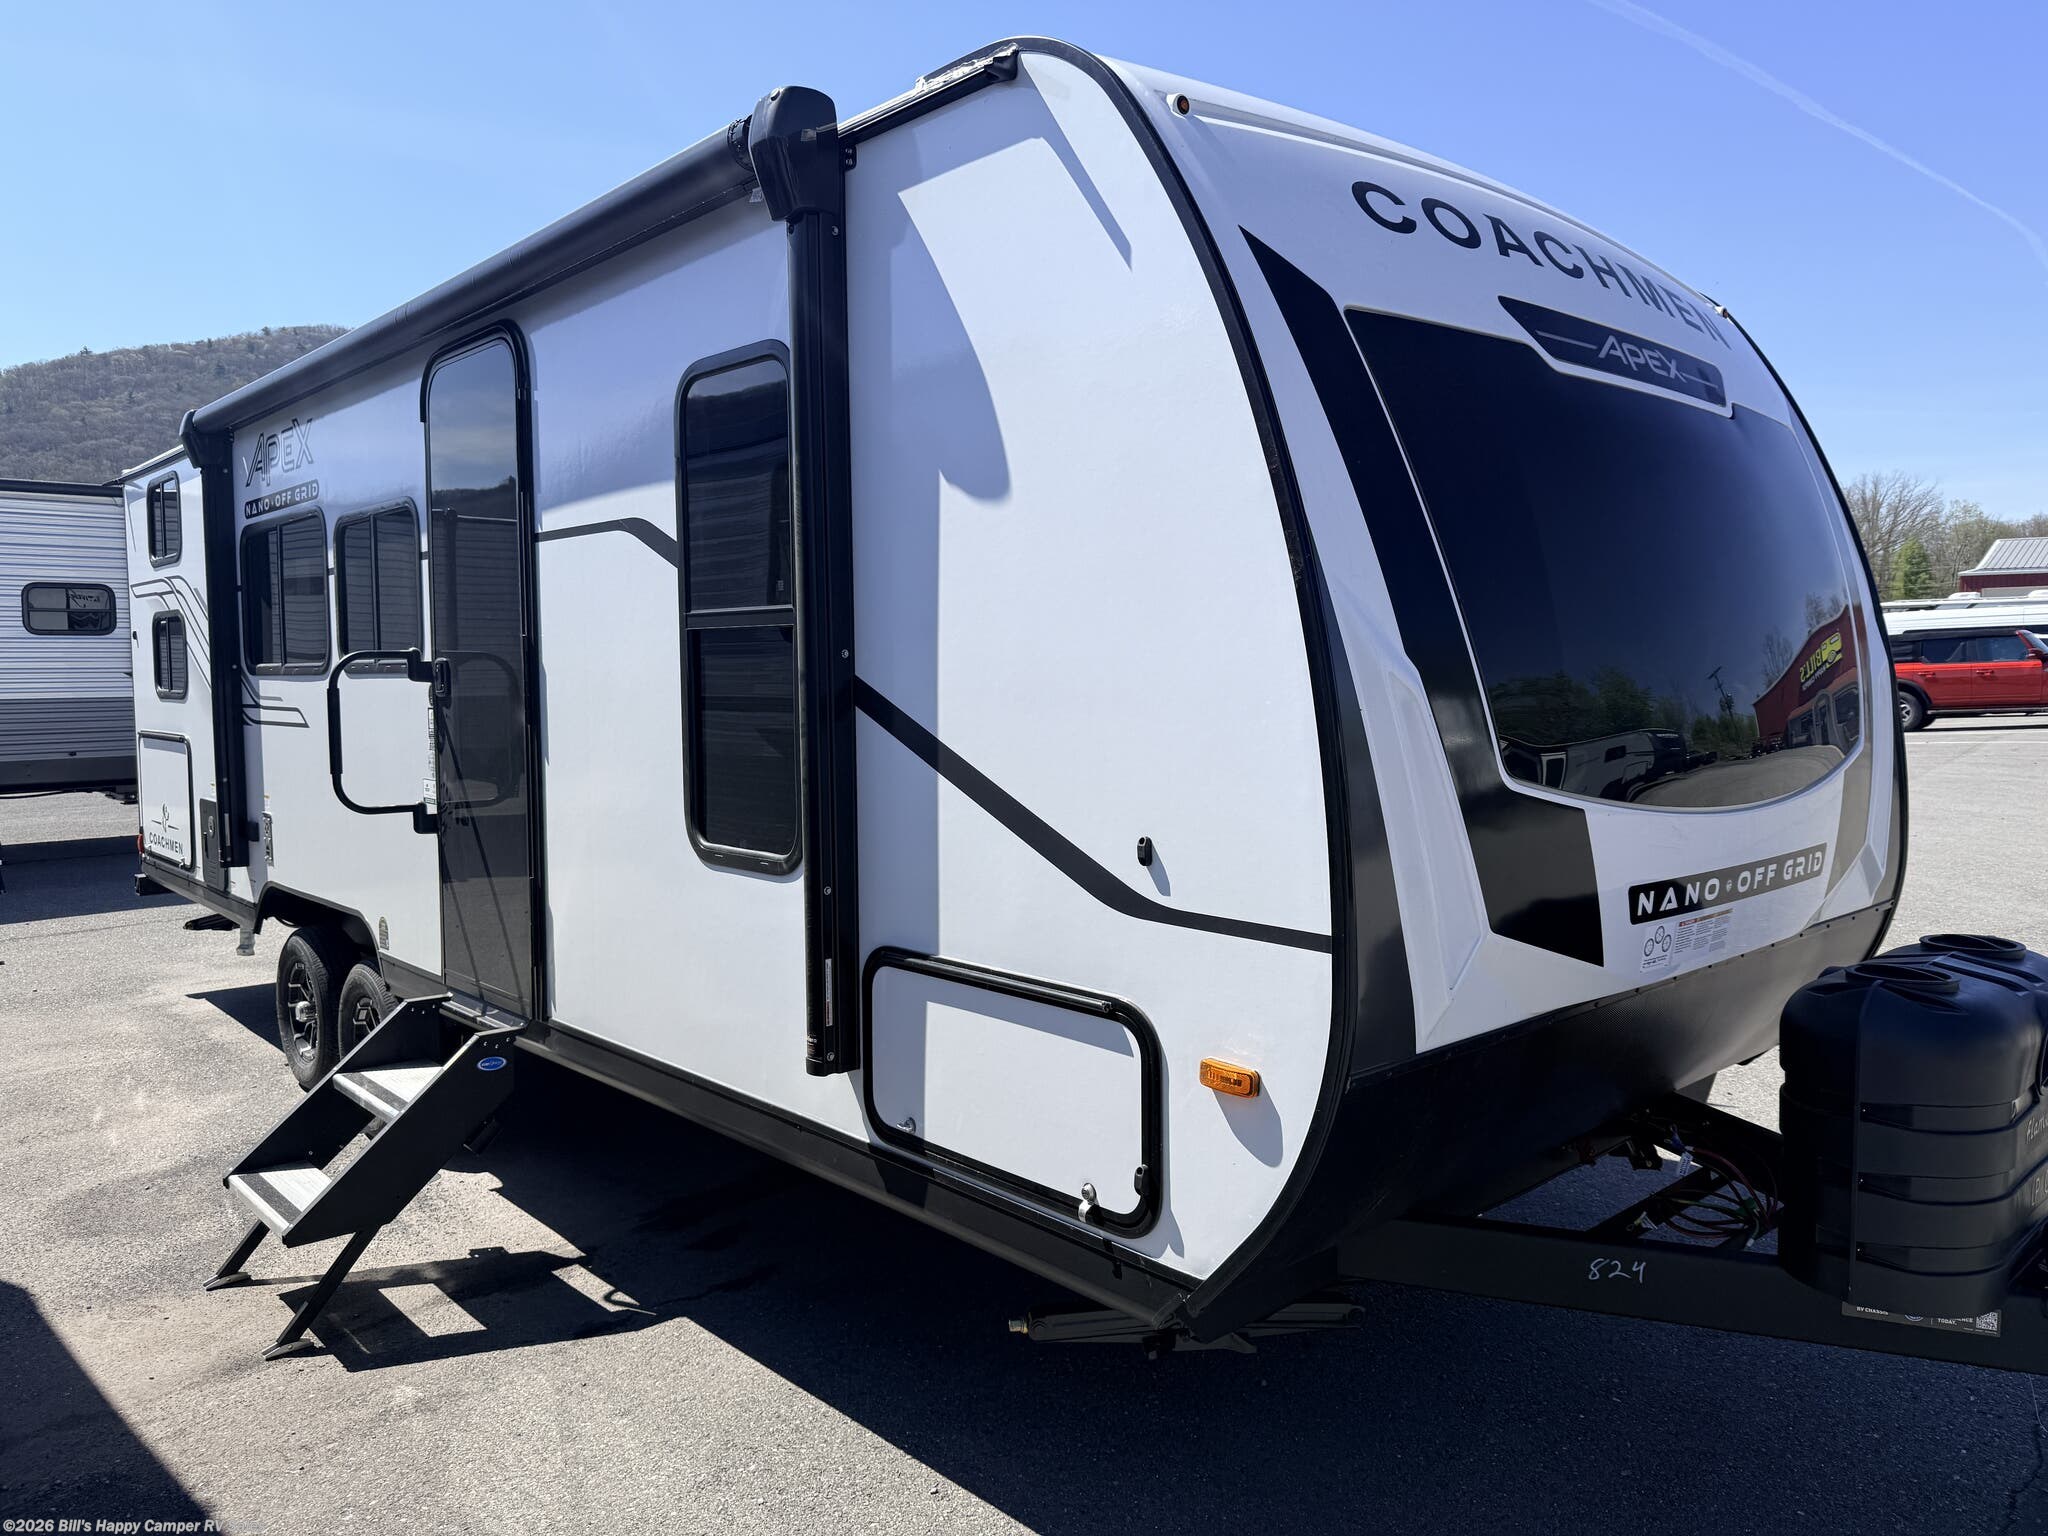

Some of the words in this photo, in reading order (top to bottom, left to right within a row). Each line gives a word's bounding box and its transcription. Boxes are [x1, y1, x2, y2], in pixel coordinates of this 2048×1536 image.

[1351, 180, 1732, 350] COACHMEN
[1598, 335, 1687, 381] APEX
[245, 419, 313, 488] APEX
[246, 498, 269, 517] NANO
[275, 492, 291, 506] OFF
[295, 484, 318, 500] GRID
[150, 832, 183, 854] COACHMEN
[1636, 877, 1720, 916] NANO
[1736, 862, 1777, 893] OFF
[1782, 850, 1823, 881] GRID
[1589, 1258, 1647, 1284] 824
